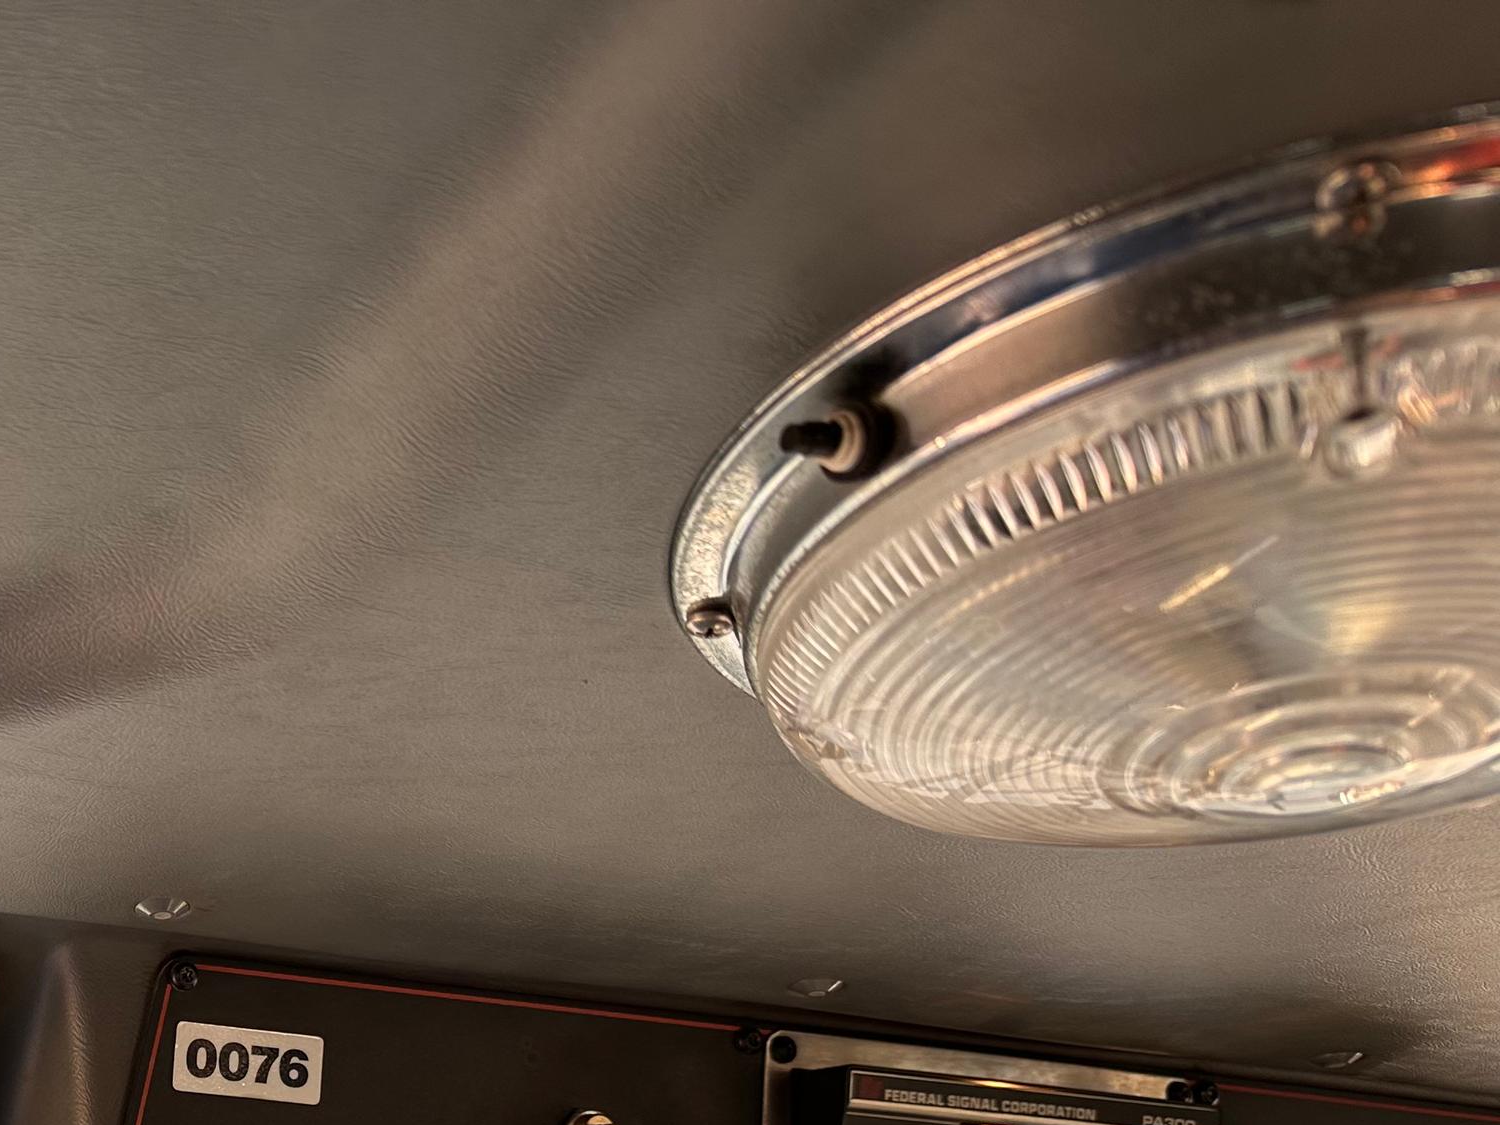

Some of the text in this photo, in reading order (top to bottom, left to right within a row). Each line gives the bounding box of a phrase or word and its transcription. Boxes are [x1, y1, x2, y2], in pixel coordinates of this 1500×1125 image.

[186, 1038, 309, 1088] 0076
[884, 1088, 1097, 1121] FEDERAL SIGNAL CORPORATION
